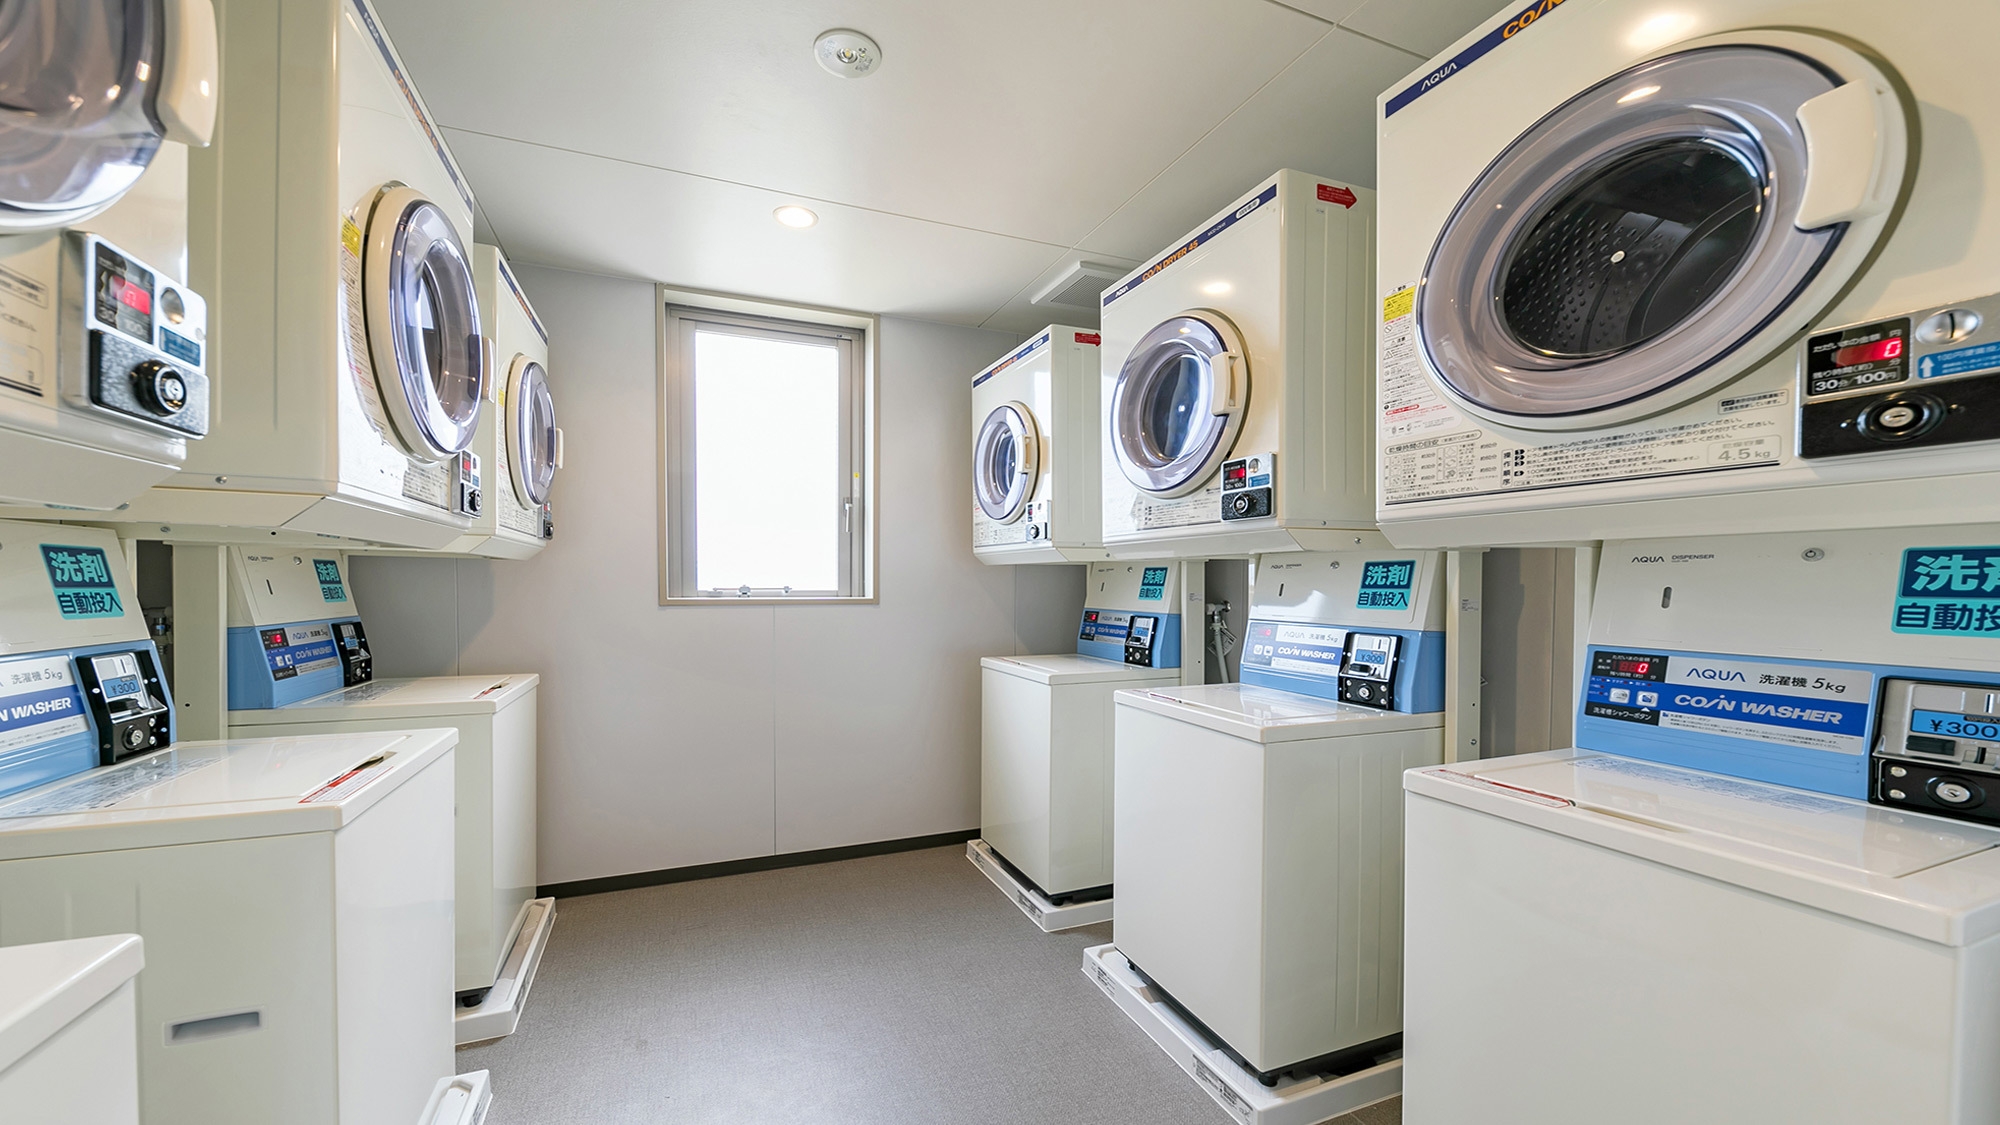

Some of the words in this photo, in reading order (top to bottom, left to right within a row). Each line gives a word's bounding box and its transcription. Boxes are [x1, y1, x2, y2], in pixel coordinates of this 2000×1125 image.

[1421, 63, 1457, 91] AQUA
[1163, 247, 1187, 269] DRYER
[1884, 340, 1901, 358] 0
[1718, 448, 1751, 461] 4.5
[1755, 450, 1771, 459] kg
[50, 551, 109, 583] 洗剤
[1365, 564, 1410, 586] 洗剤
[1911, 554, 2000, 592] 洗
[57, 591, 123, 614] 自動投入
[1357, 591, 1409, 607] 自動投入
[1278, 646, 1300, 656] COIN
[1301, 648, 1336, 660] WASHER
[1361, 653, 1381, 663] ¥300
[11, 670, 42, 685] 洗濯機
[44, 668, 63, 681] 5kg
[1638, 662, 1648, 674] 0
[111, 681, 136, 696] ¥300
[1686, 667, 1746, 684] AQUA
[1759, 673, 1808, 689] 洗濯機
[1812, 677, 1847, 694] 5kg
[11, 697, 72, 720] WASHER
[1674, 693, 1735, 713] COIN
[1740, 701, 1843, 726] WASHER
[1930, 718, 1999, 739] ¥300
